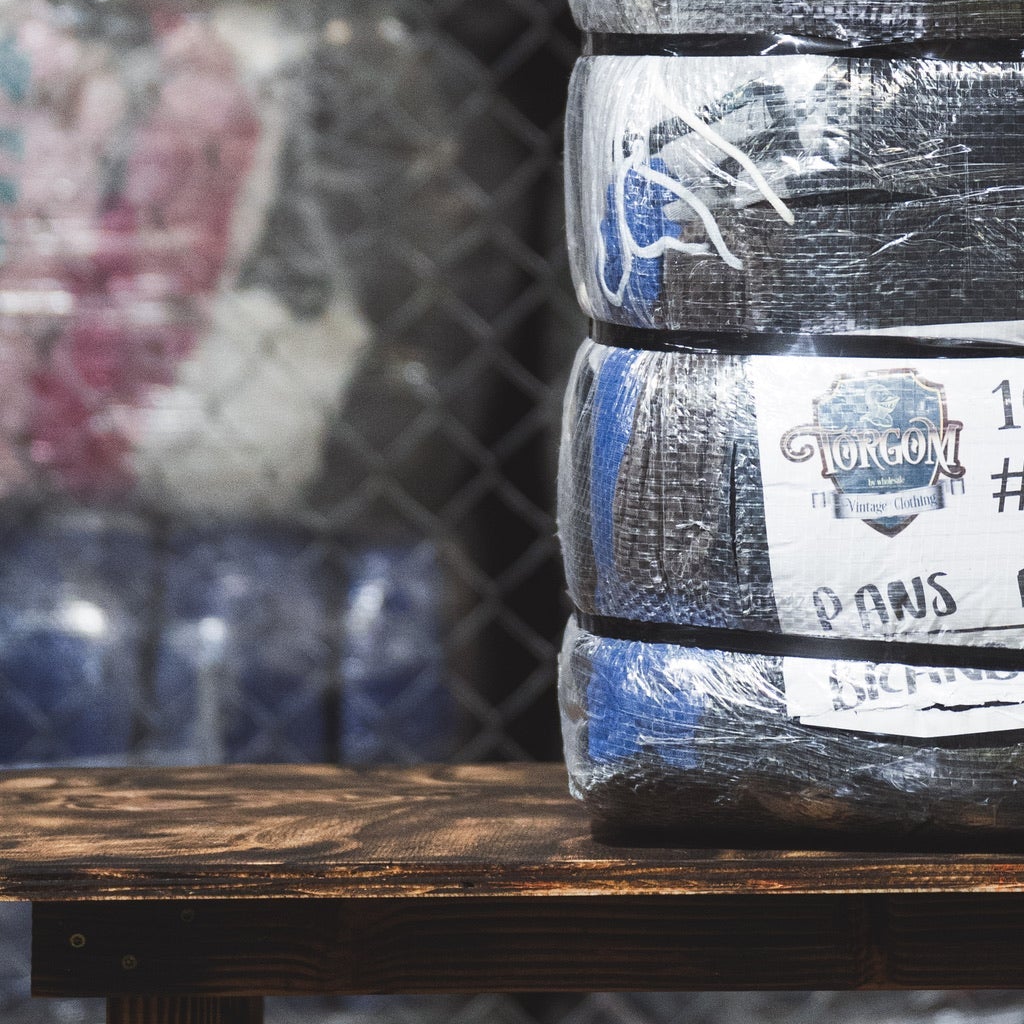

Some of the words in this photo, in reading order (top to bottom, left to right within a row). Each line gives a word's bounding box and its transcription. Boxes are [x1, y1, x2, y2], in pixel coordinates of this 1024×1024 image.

[780, 416, 967, 479] TORGOM
[846, 498, 888, 514] Vintage
[894, 493, 938, 510] Clothing
